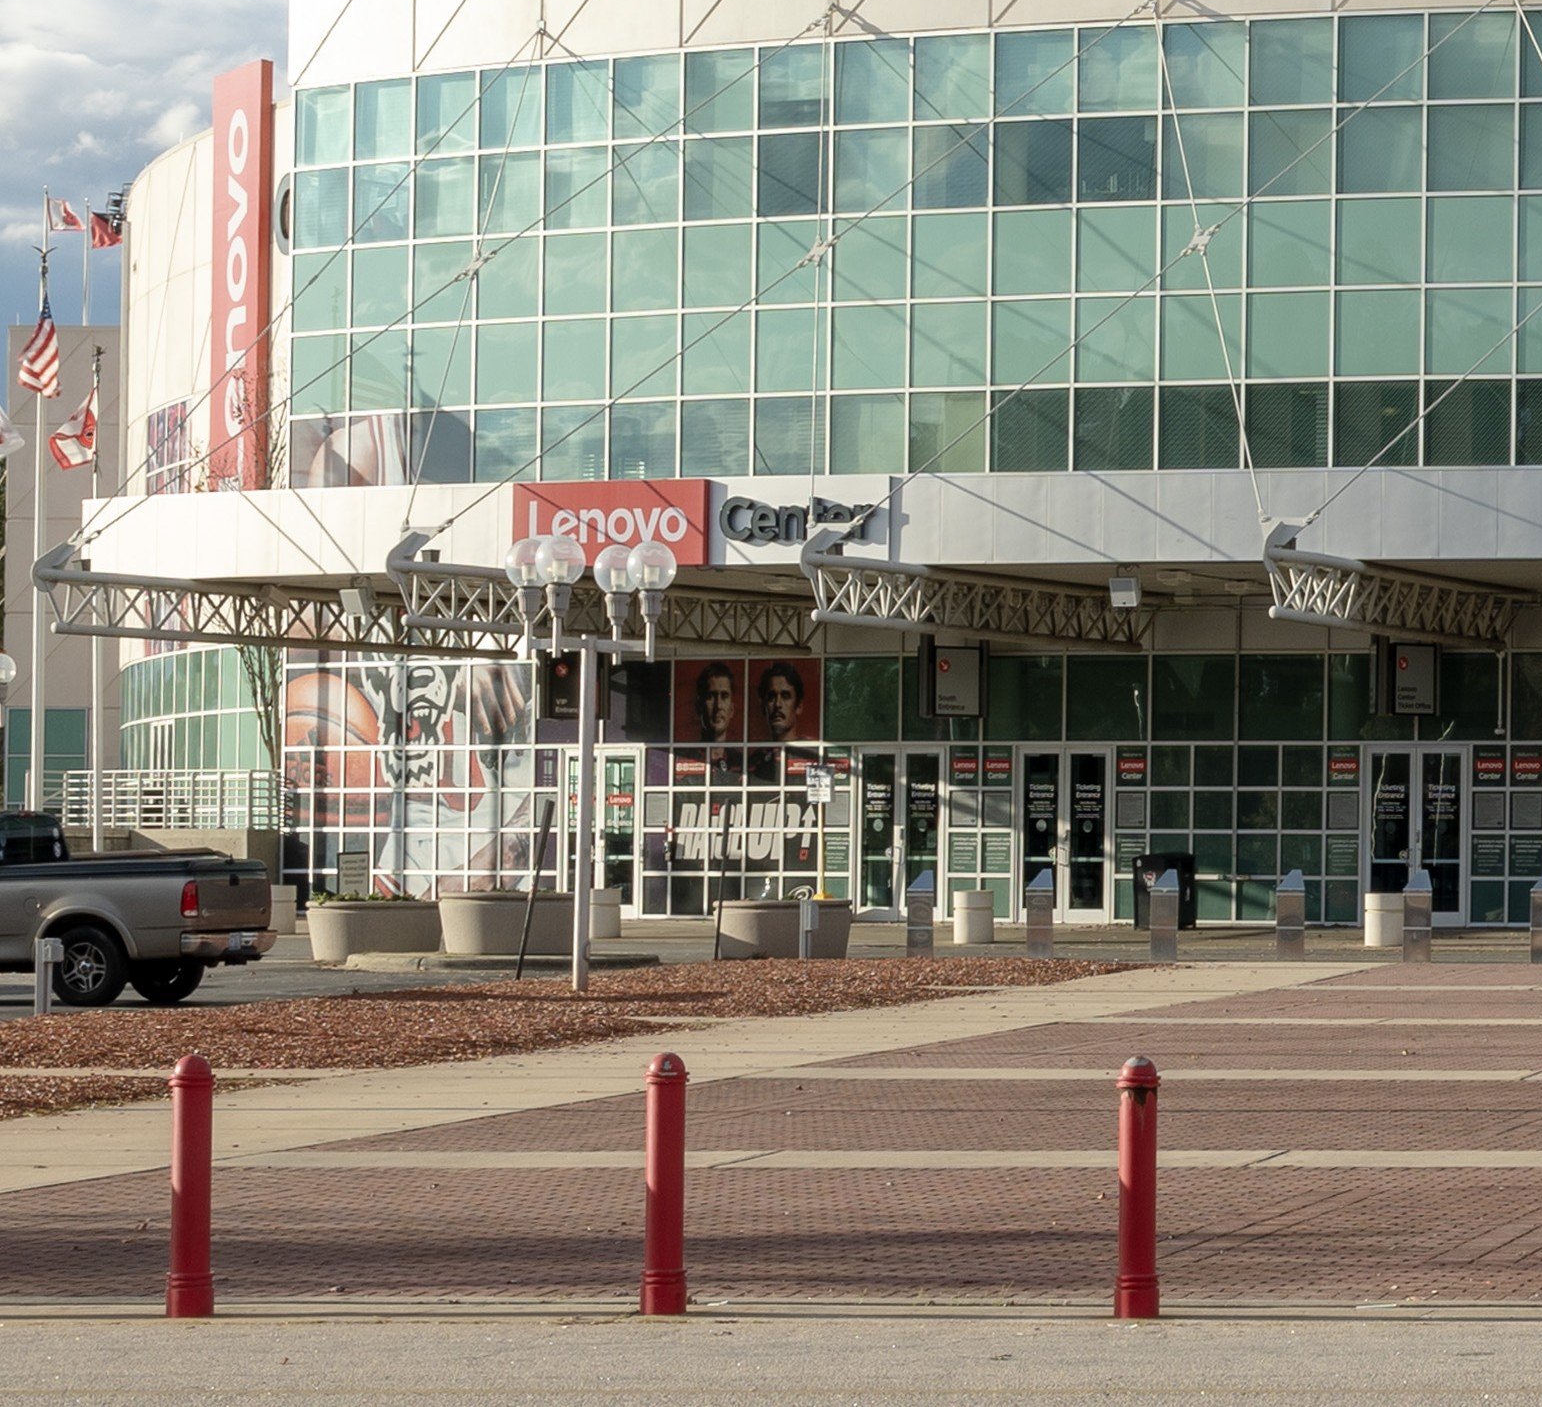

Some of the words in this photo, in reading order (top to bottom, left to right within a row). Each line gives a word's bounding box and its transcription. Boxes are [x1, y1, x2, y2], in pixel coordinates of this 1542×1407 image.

[529, 500, 688, 543] Lenovo
[986, 761, 1010, 769] Lenovo
[1120, 761, 1144, 769] Lenovo
[1331, 762, 1357, 770] Lenovo
[1477, 762, 1503, 770] Lenovo
[1514, 762, 1541, 770] Lenovo
[1478, 772, 1501, 780] Center
[1516, 772, 1539, 781] Center
[1029, 784, 1055, 792] Ticketing
[1075, 784, 1101, 792] Ticketing
